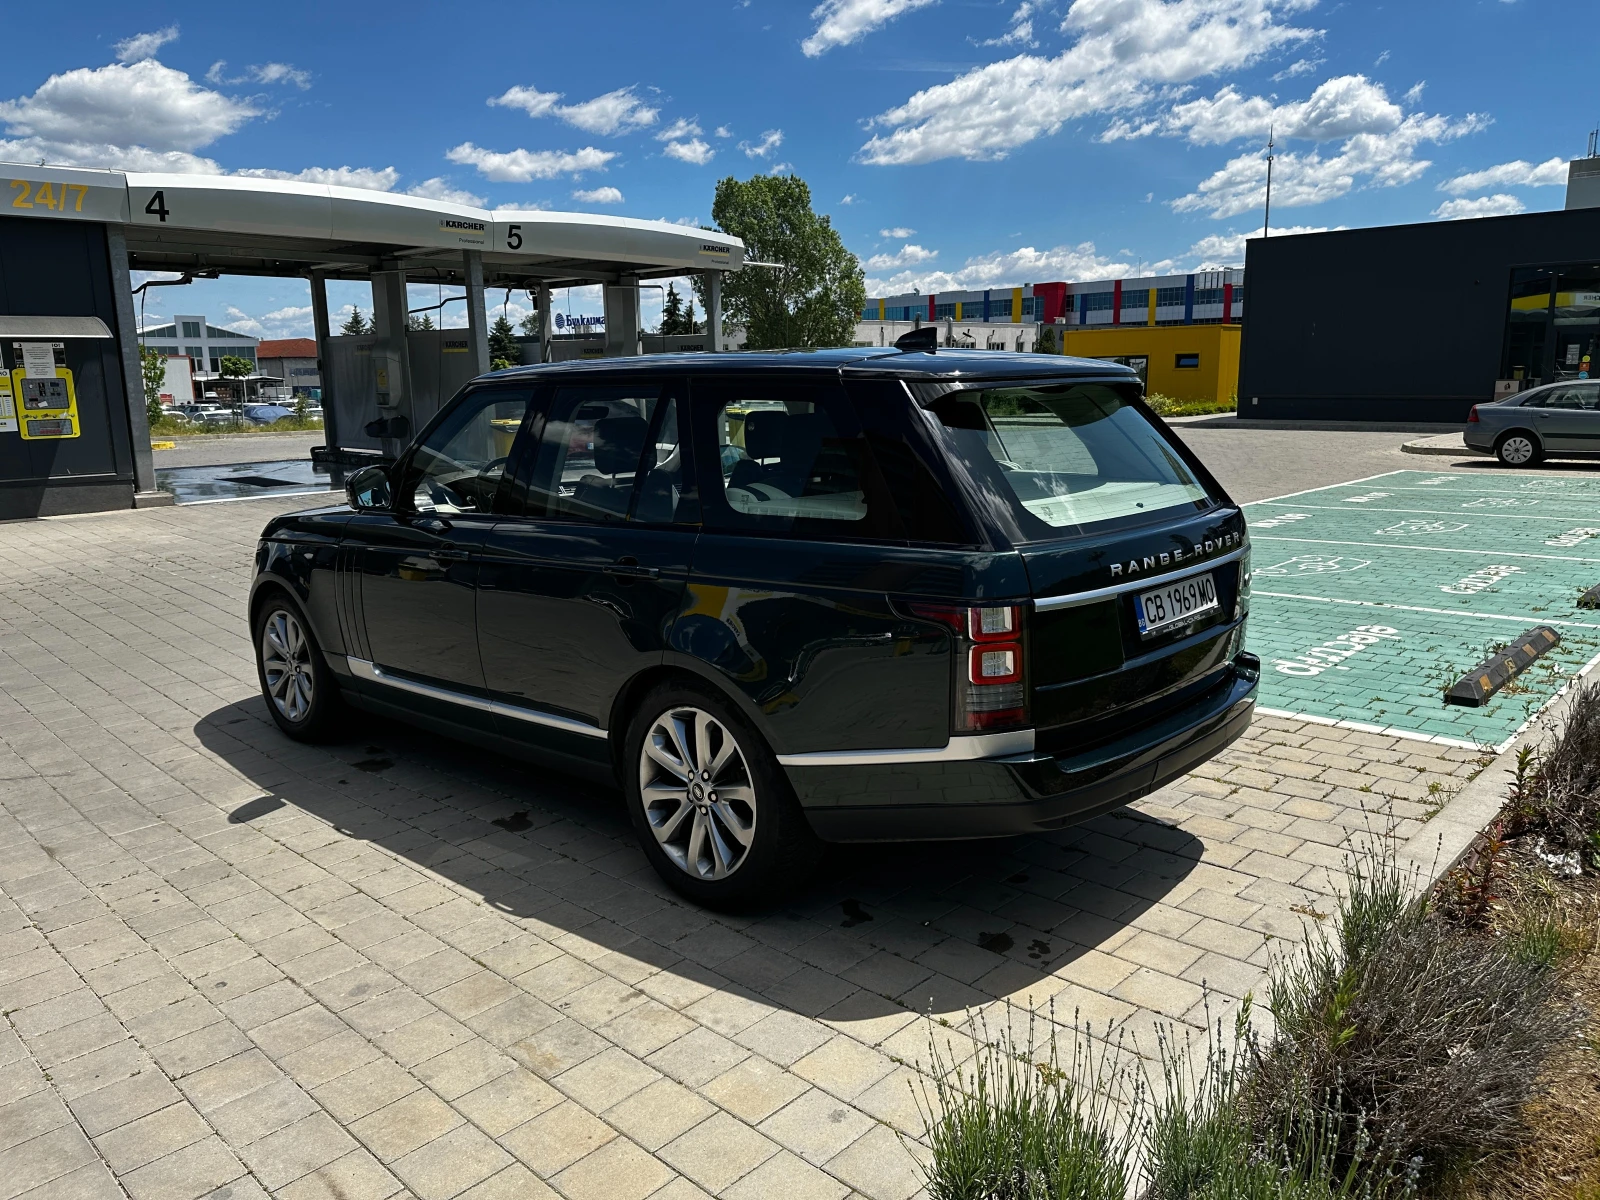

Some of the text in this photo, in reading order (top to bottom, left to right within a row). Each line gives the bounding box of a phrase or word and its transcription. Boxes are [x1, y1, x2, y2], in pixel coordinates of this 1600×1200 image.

[10, 179, 89, 213] 24/7
[145, 190, 169, 222] 4
[446, 220, 485, 231] KÄRCHER
[507, 225, 523, 250] 5
[1110, 531, 1241, 577] RANGE ROVER
[1145, 594, 1166, 624] CB
[1167, 583, 1197, 616] 1969
[1197, 578, 1215, 606] MO
